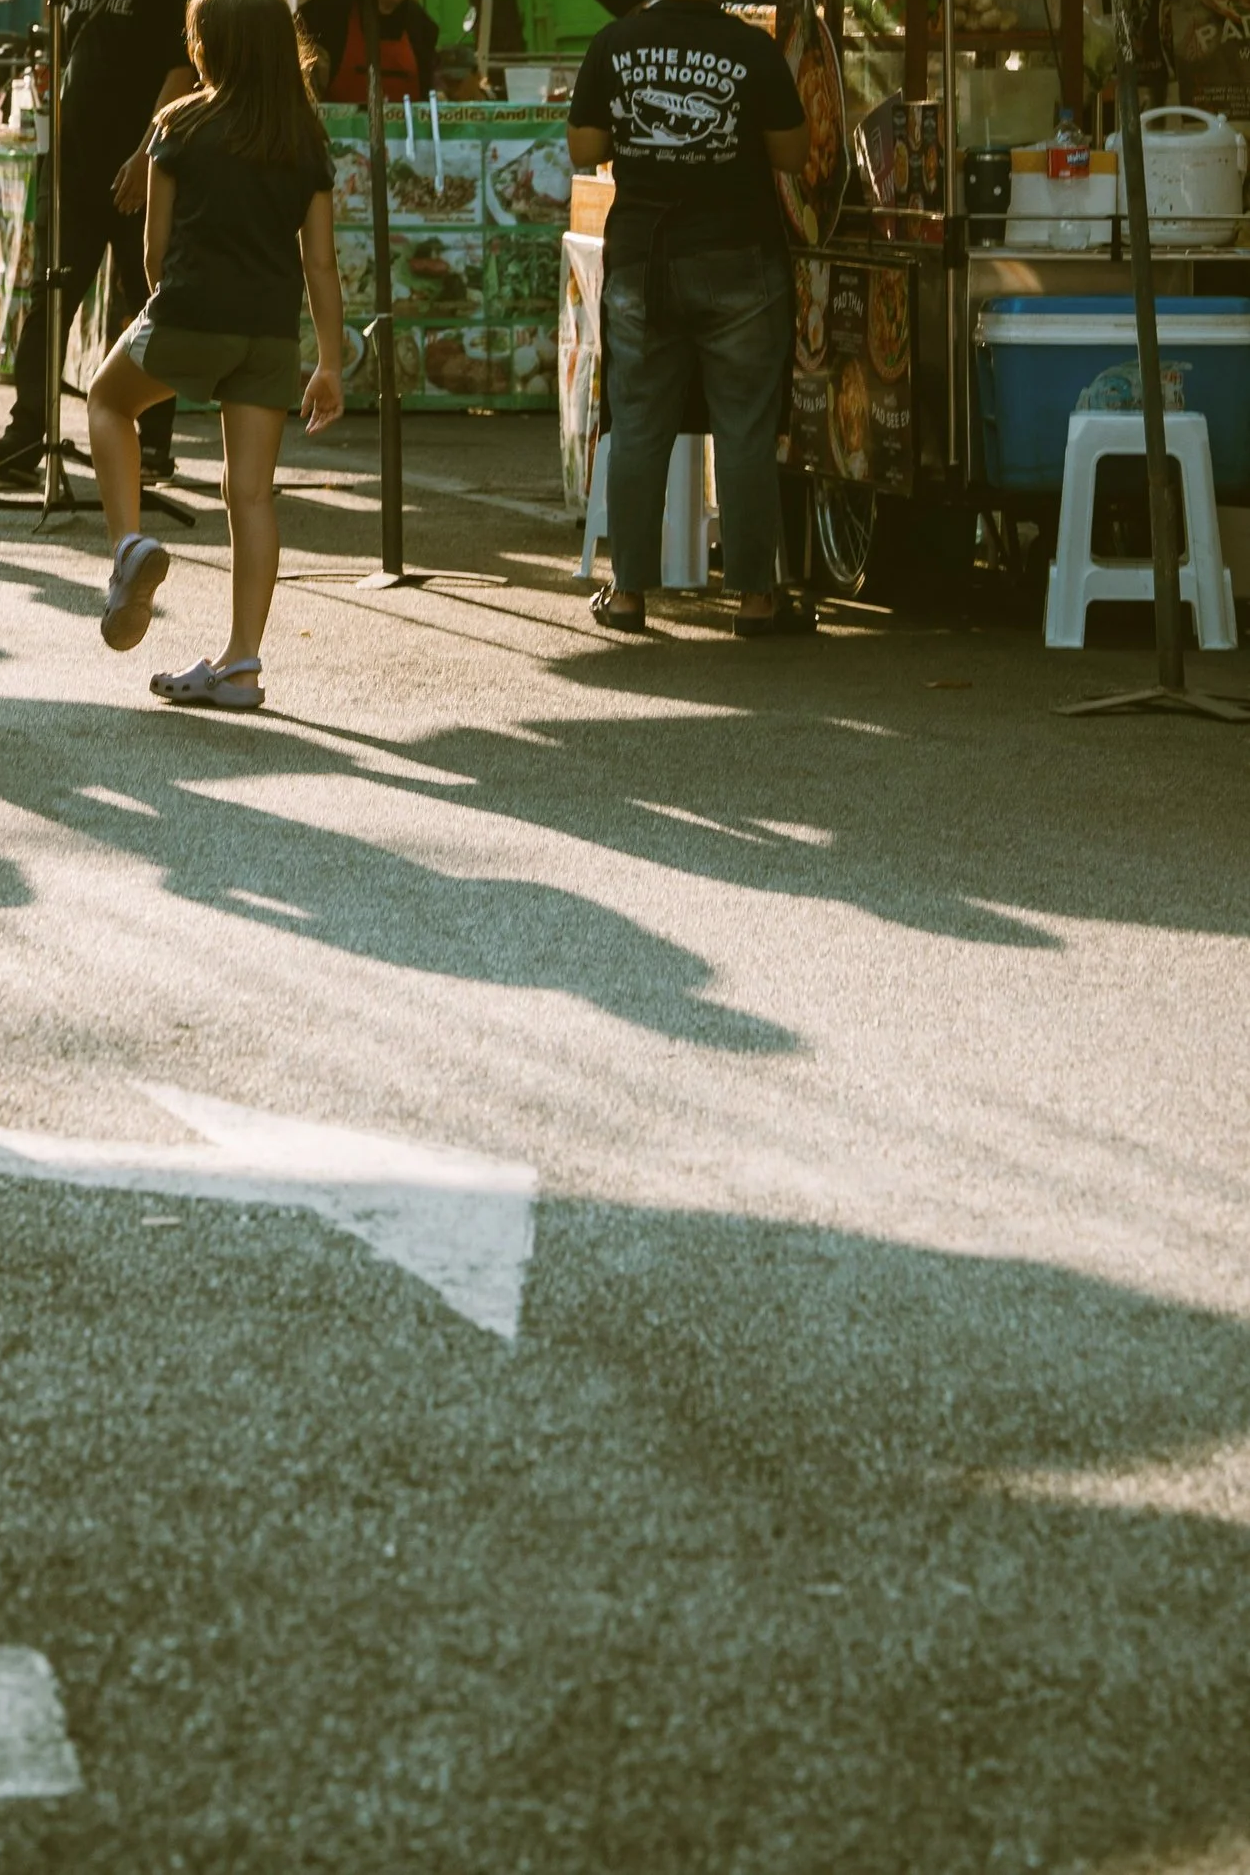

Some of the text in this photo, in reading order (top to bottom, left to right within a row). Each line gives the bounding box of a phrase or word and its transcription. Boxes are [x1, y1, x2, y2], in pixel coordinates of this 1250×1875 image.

[611, 46, 748, 81] IN THE MOOD
[621, 64, 733, 93] FOR NOODS
[419, 107, 487, 123] Noodles
[493, 107, 526, 122] And
[535, 106, 569, 122] Rice
[833, 290, 864, 318] PAD THAI
[871, 400, 886, 426] PAD
[886, 410, 900, 429] SEE
